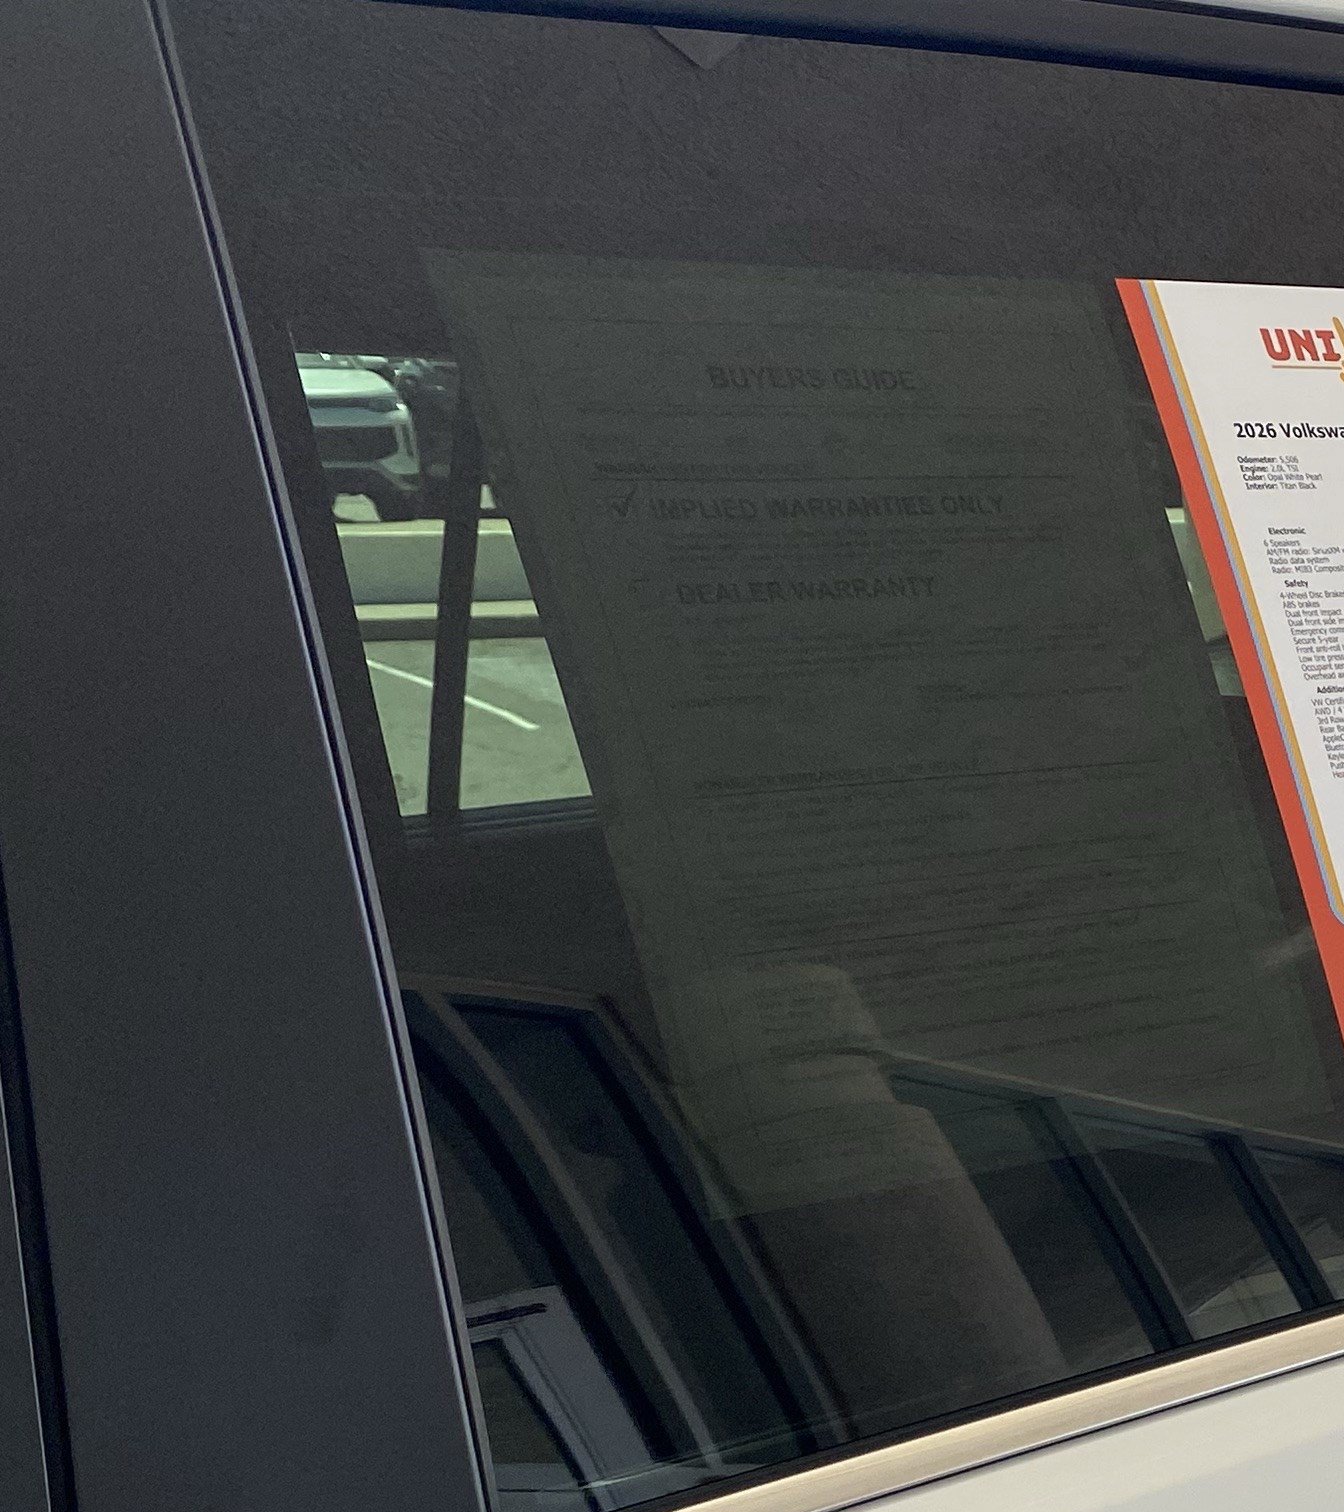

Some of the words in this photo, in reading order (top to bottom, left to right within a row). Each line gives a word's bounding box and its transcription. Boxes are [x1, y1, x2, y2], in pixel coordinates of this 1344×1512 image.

[706, 365, 825, 389] BUYERS
[832, 367, 918, 391] GUIDE
[1234, 421, 1276, 440] 2026
[650, 498, 757, 520] IMPLIED
[765, 496, 934, 519] WARRANTIES
[941, 495, 1005, 516] ONLY
[675, 580, 786, 604] DEALER
[790, 576, 935, 601] WARRANTY
[1284, 580, 1309, 589] Safety
